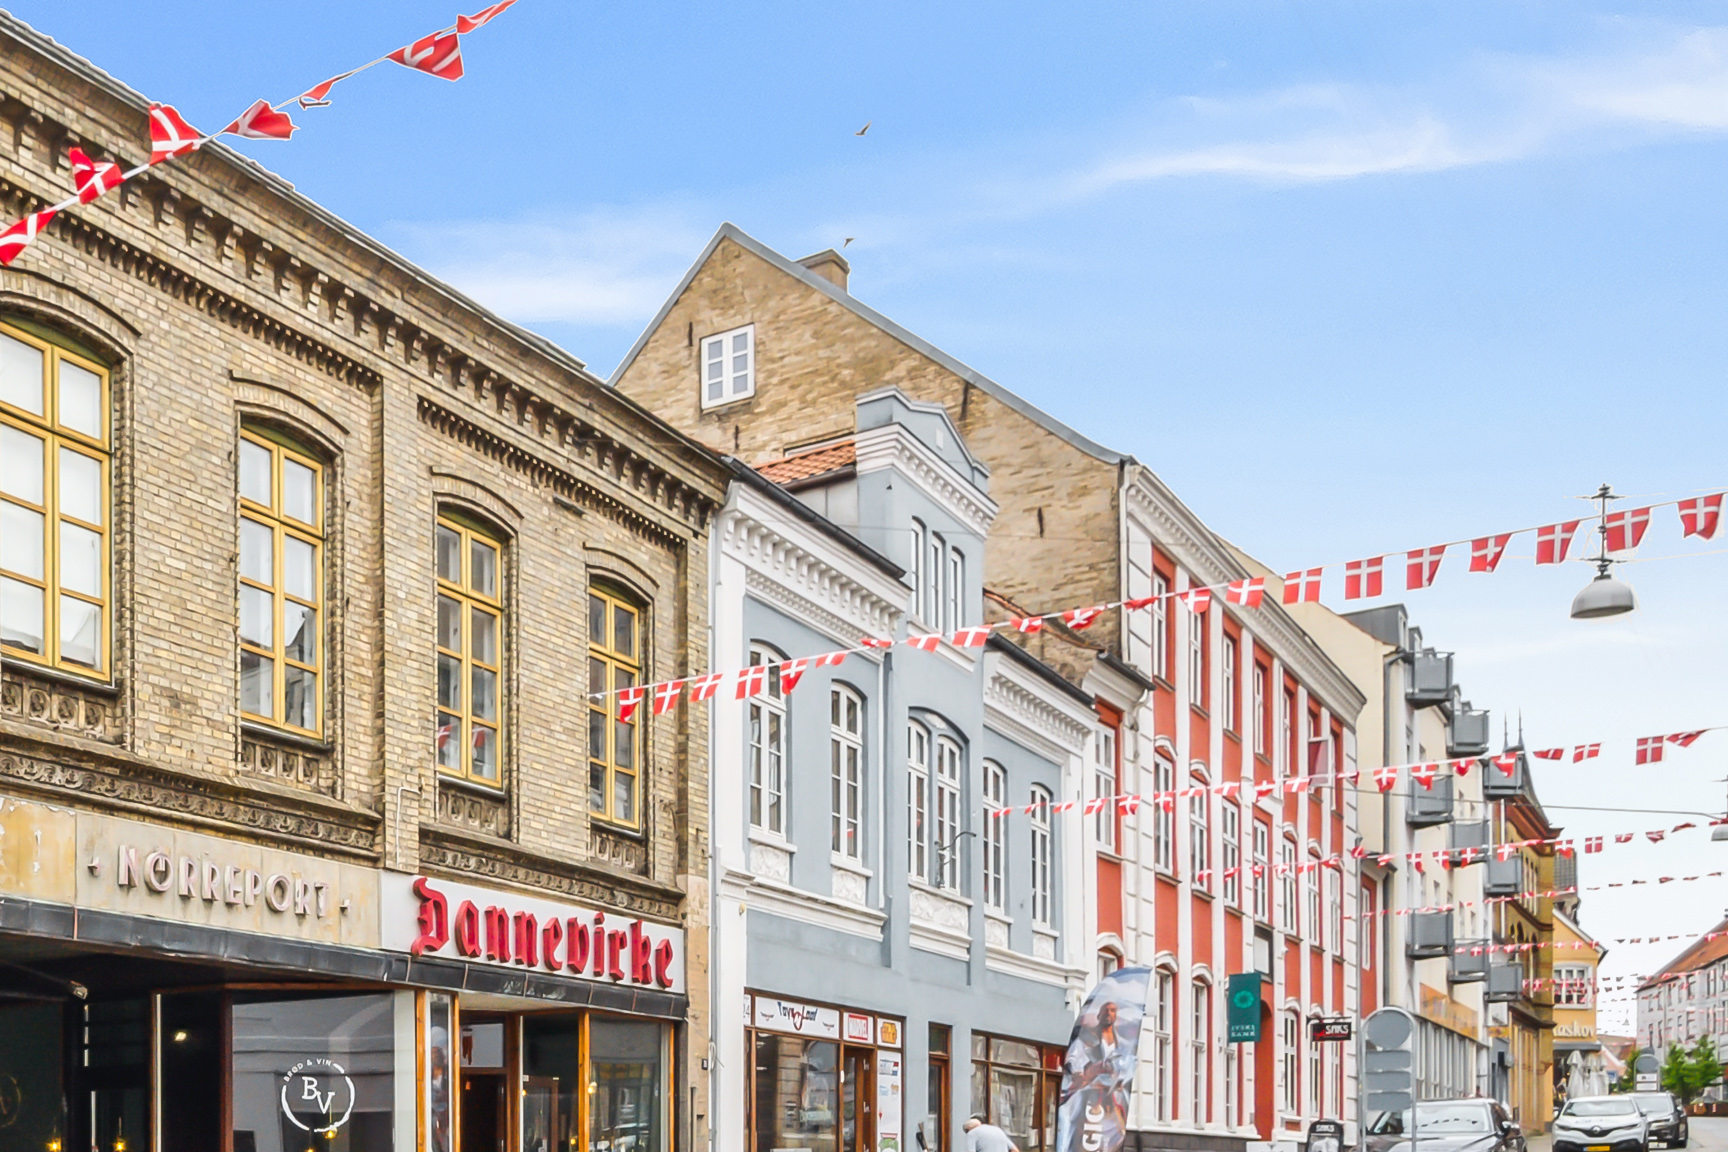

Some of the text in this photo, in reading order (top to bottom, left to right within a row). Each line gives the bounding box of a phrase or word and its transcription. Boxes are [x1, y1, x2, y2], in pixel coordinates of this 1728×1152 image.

[410, 876, 674, 989] Dannevirke
[283, 1061, 304, 1083] BRØD
[316, 1058, 332, 1067] VIN
